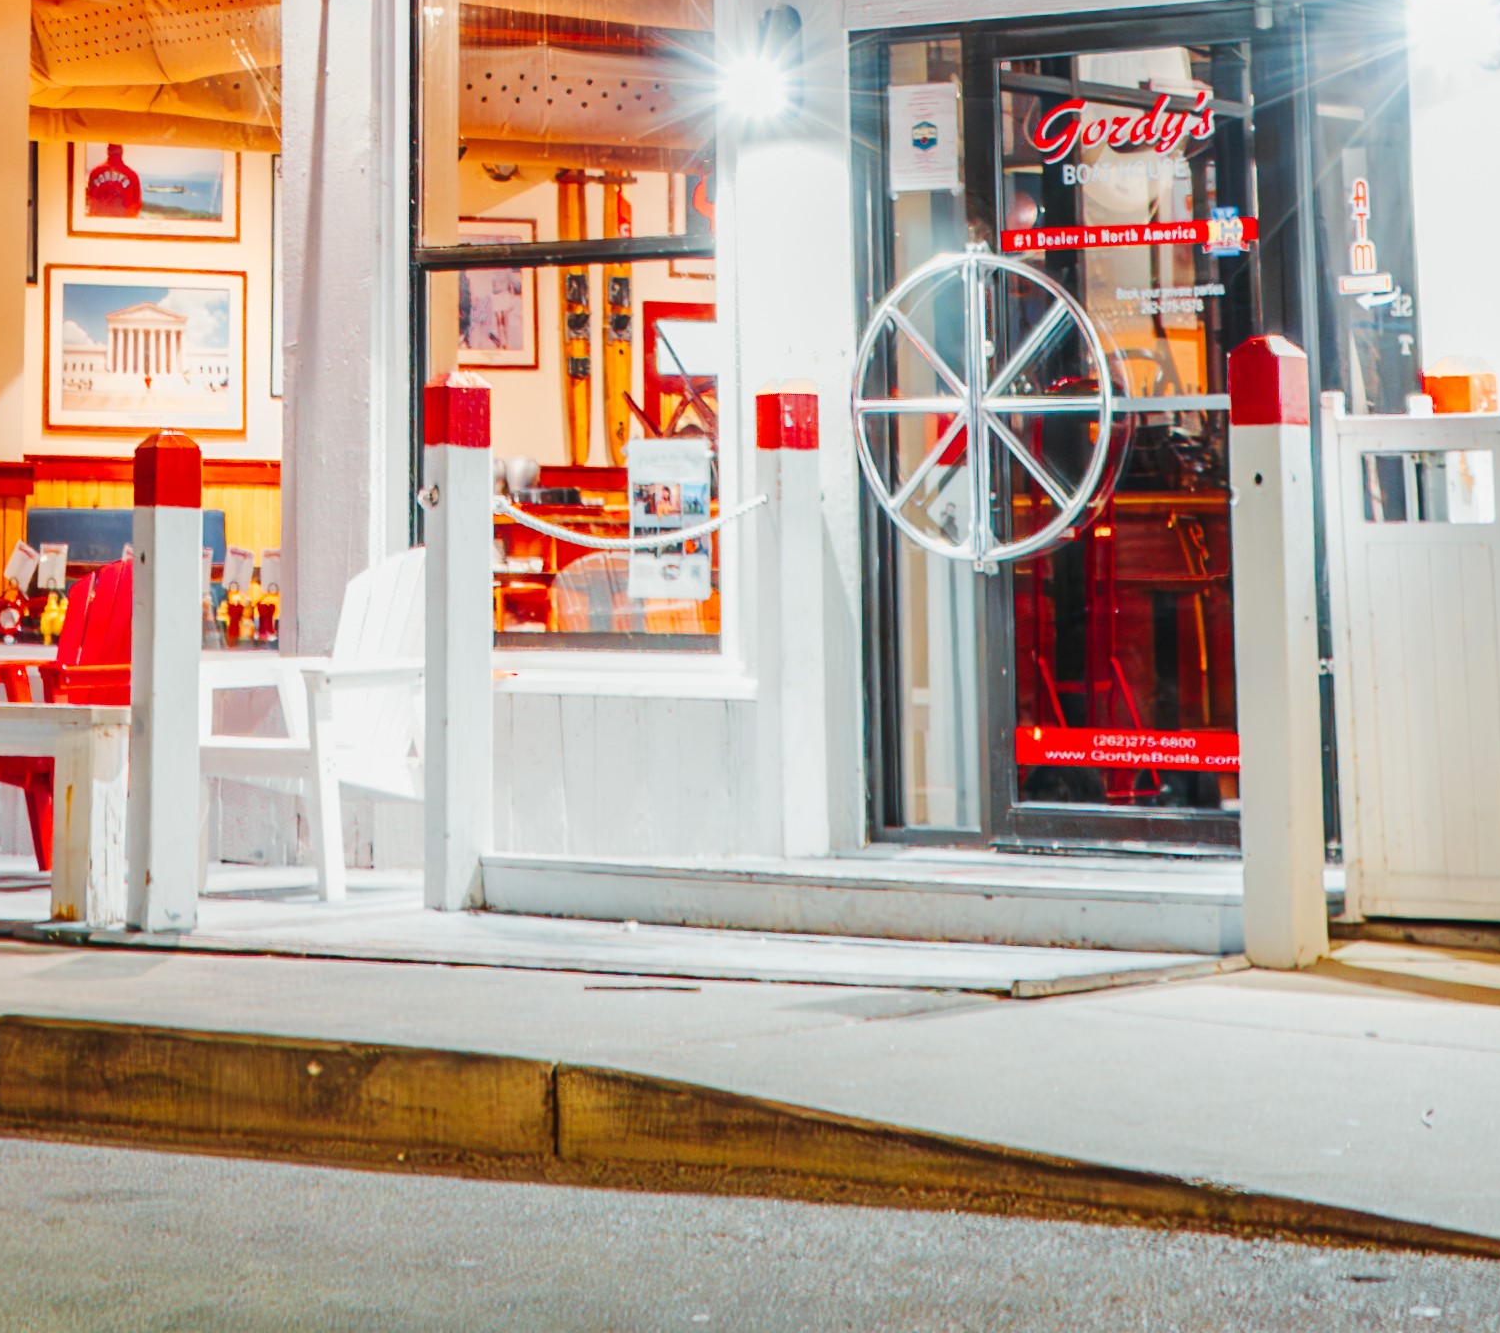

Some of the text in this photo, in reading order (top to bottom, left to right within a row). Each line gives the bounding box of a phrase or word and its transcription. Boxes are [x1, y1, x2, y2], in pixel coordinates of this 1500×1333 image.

[1032, 91, 1215, 165] Gordy's
[1062, 161, 1112, 186] BOAT
[1013, 224, 1198, 248] #1 Dealer in North America
[1351, 179, 1375, 272] ATM
